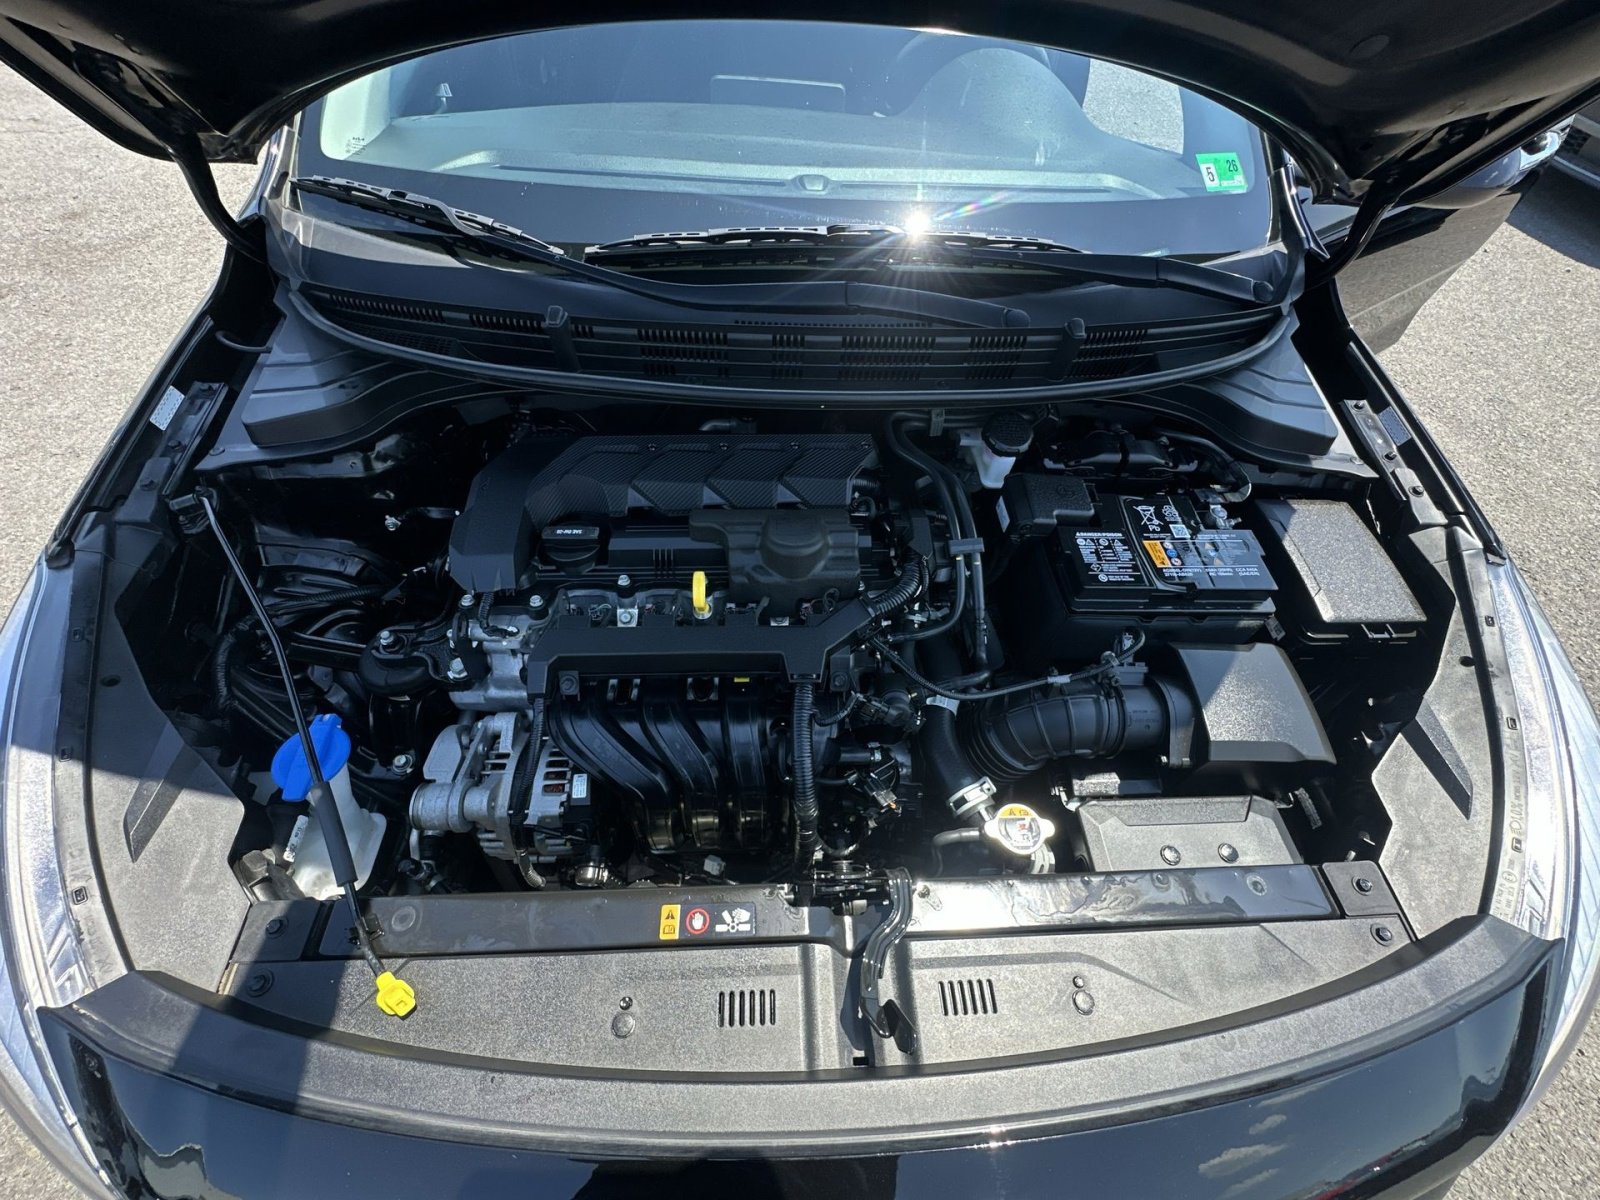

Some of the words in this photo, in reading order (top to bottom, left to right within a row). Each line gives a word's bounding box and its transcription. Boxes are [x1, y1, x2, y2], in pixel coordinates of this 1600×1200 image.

[1226, 159, 1239, 172] 26
[1205, 166, 1215, 182] 5
[1148, 524, 1161, 532] Pb
